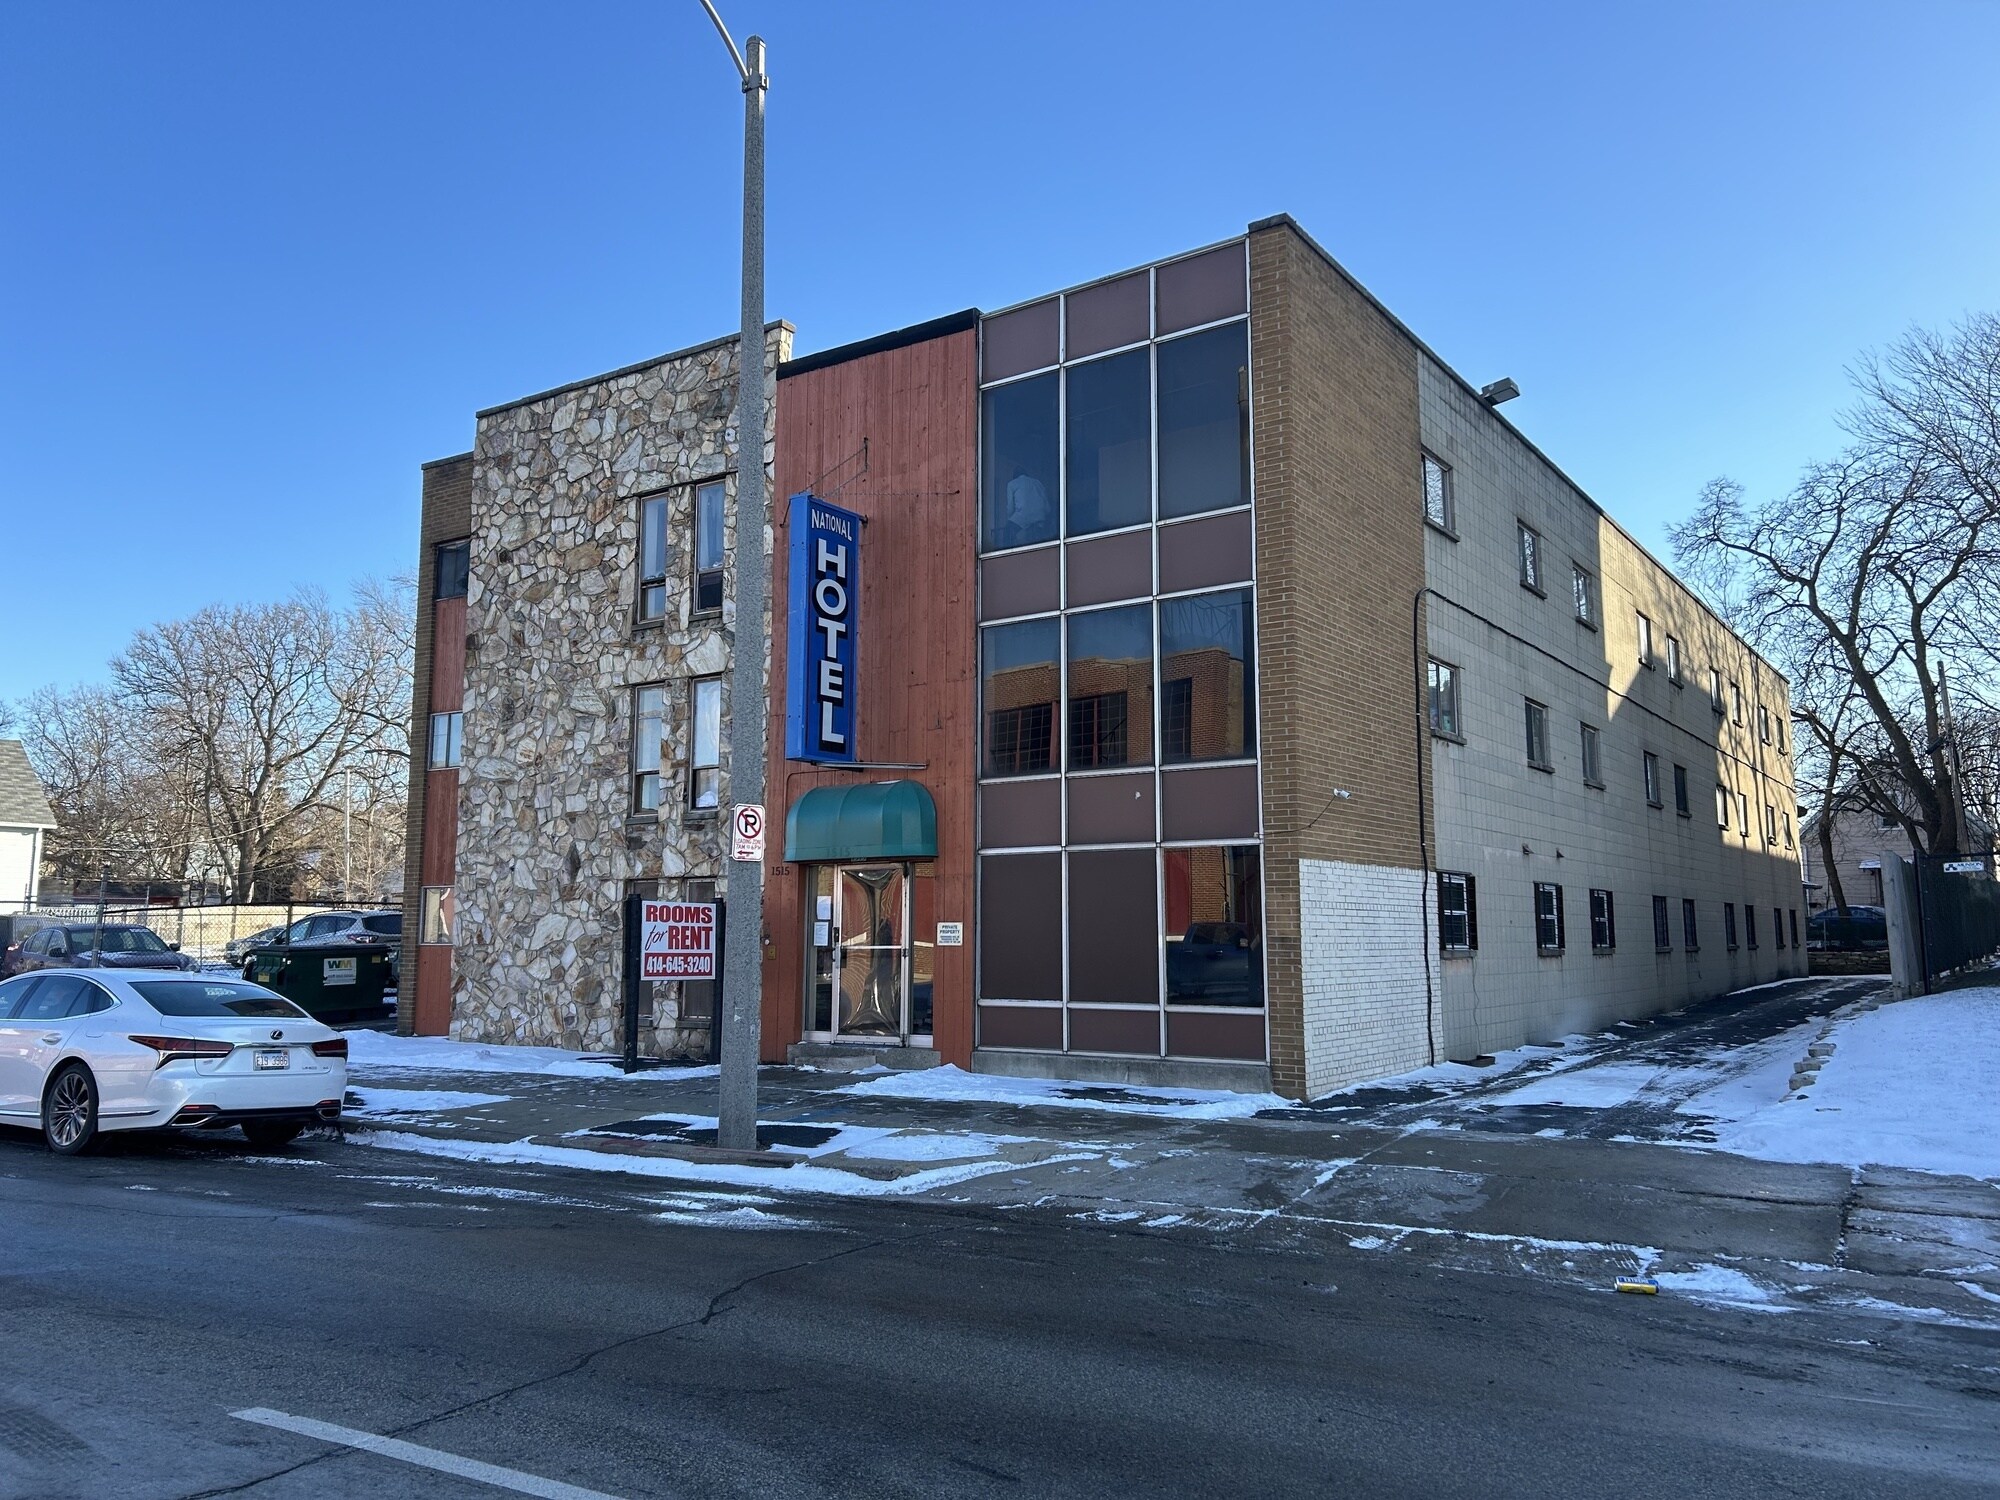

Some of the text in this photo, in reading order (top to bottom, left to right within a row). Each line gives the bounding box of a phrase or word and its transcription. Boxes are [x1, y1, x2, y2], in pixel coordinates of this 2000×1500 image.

[811, 508, 853, 541] NATIONAL
[816, 538, 847, 744] HOTEL
[771, 866, 790, 876] 1515
[645, 904, 713, 924] ROOMS
[644, 924, 713, 951] for RENT
[327, 959, 353, 969] WM
[646, 956, 711, 974] 414-645-3240
